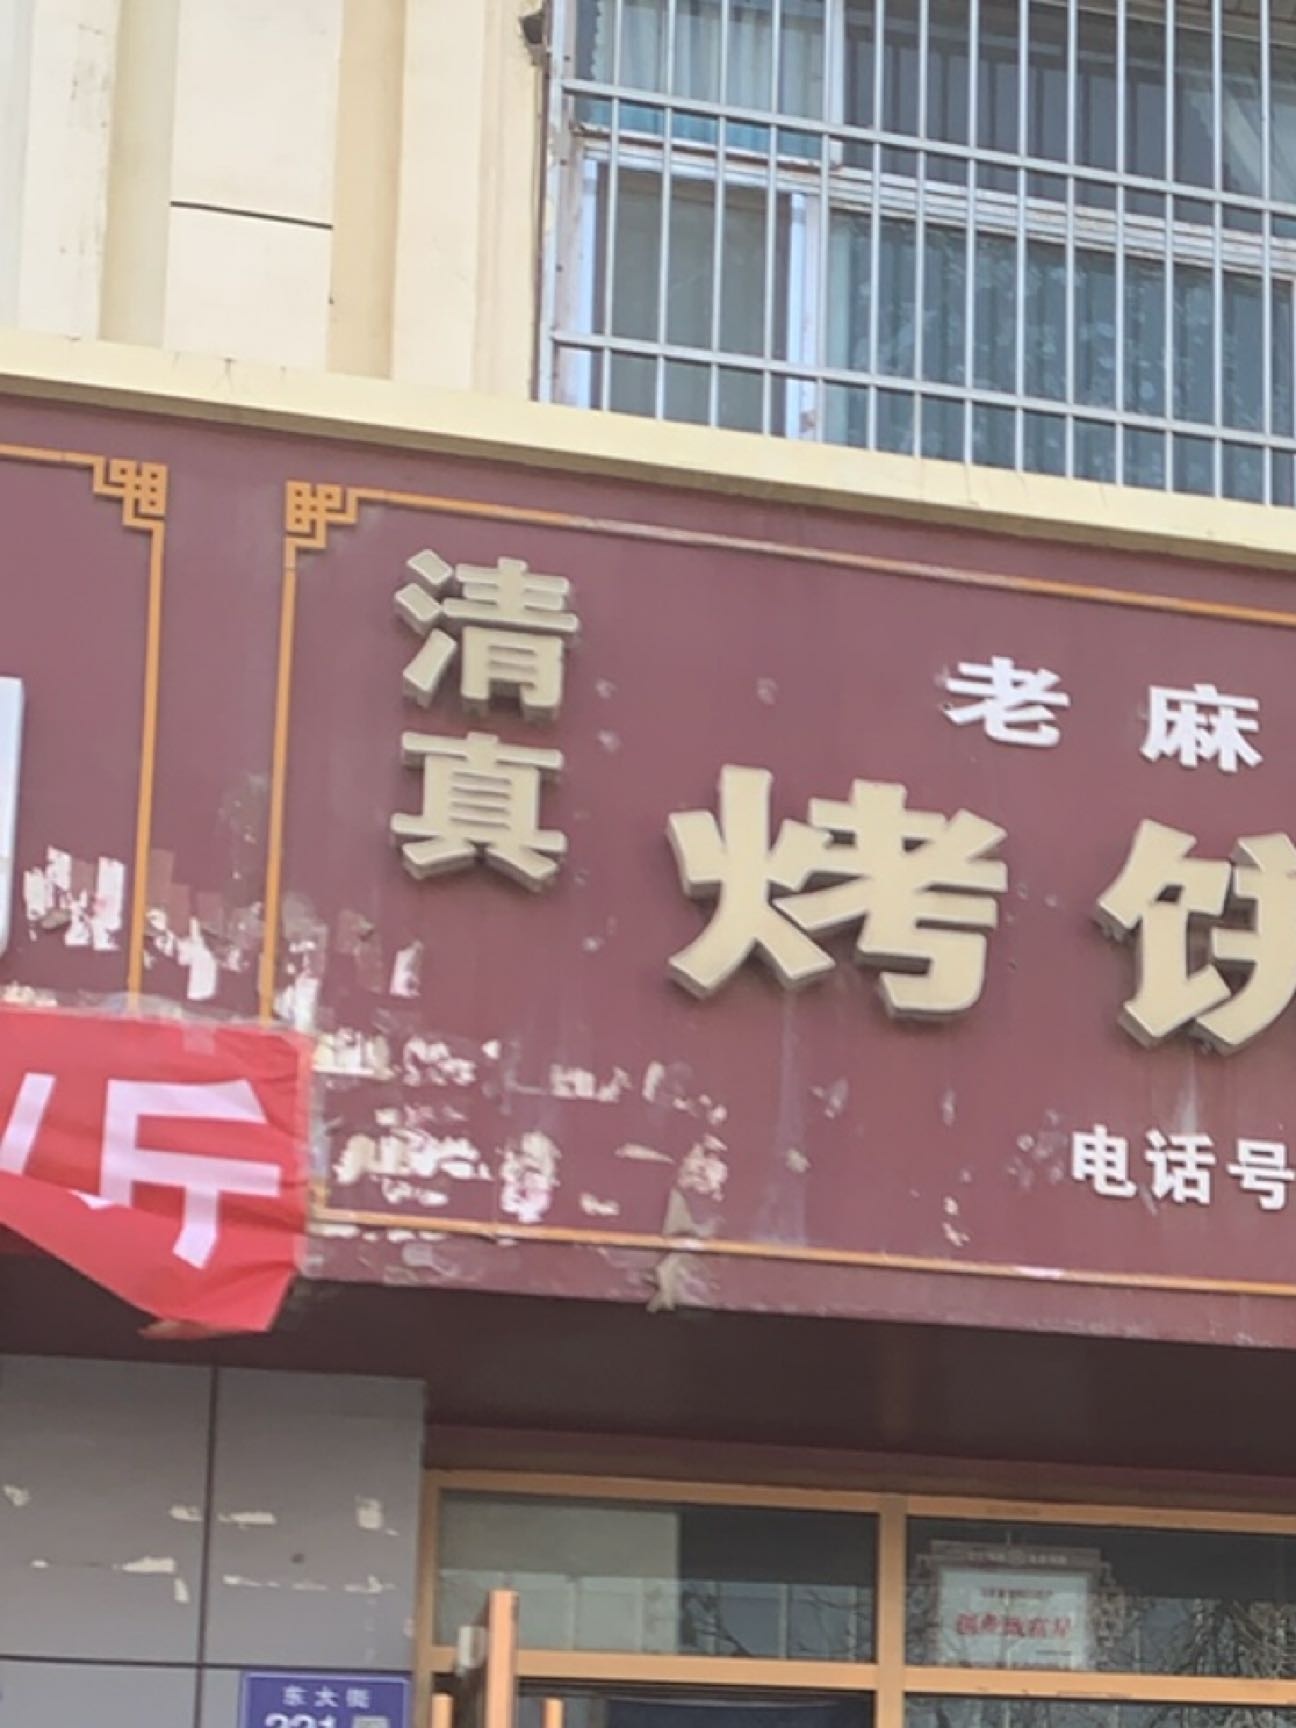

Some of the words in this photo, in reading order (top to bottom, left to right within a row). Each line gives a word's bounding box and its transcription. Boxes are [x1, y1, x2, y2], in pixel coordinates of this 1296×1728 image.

[391, 549, 579, 891] 清真
[282, 1684, 371, 1709] 东大街
